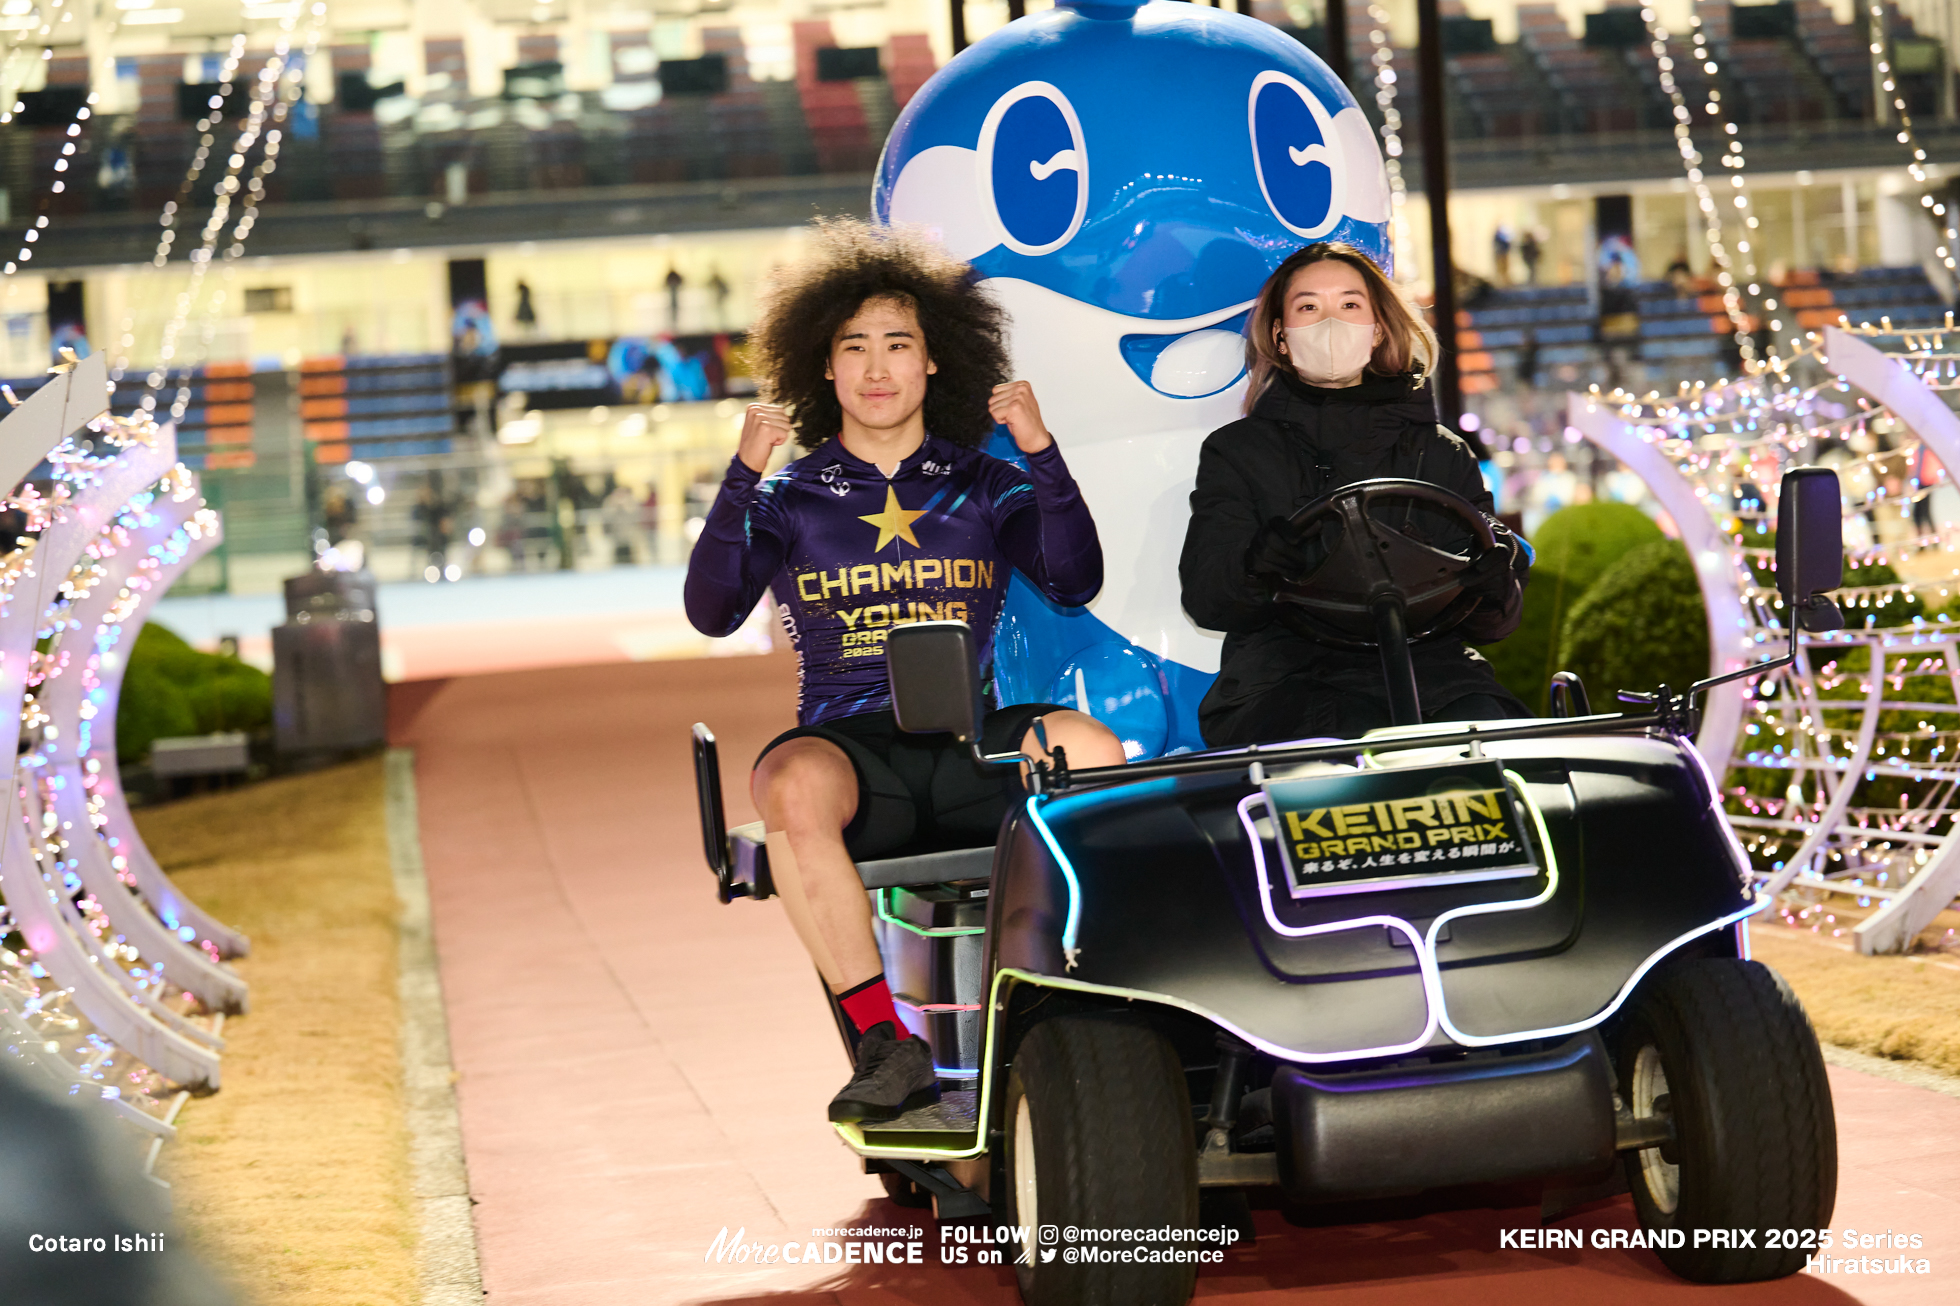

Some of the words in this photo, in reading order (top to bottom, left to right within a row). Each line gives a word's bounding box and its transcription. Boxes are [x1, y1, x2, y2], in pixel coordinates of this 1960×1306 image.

[796, 558, 994, 602] CHAMPION
[836, 601, 968, 631] YOUNG
[843, 645, 884, 658] 2025
[1285, 793, 1503, 841] KEIRIN
[1295, 831, 1422, 860] GRAND
[1426, 822, 1509, 847] PRIX
